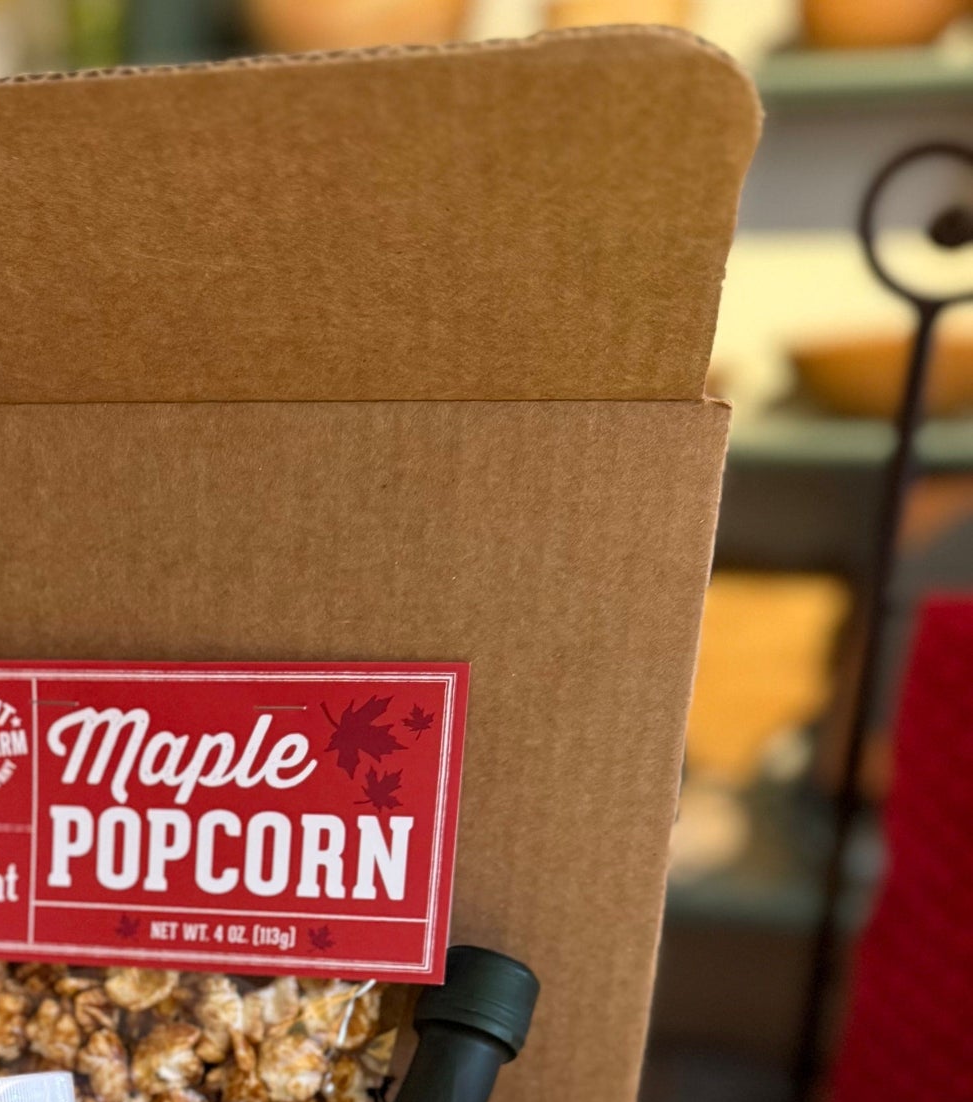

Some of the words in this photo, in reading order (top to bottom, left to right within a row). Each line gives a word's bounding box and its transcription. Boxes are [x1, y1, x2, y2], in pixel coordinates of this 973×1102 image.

[47, 706, 319, 804] Maple
[47, 804, 415, 901] POPCORN
[150, 921, 179, 941] NET
[182, 922, 210, 943] WT.
[213, 924, 224, 943] 4
[227, 924, 249, 944] OZ.
